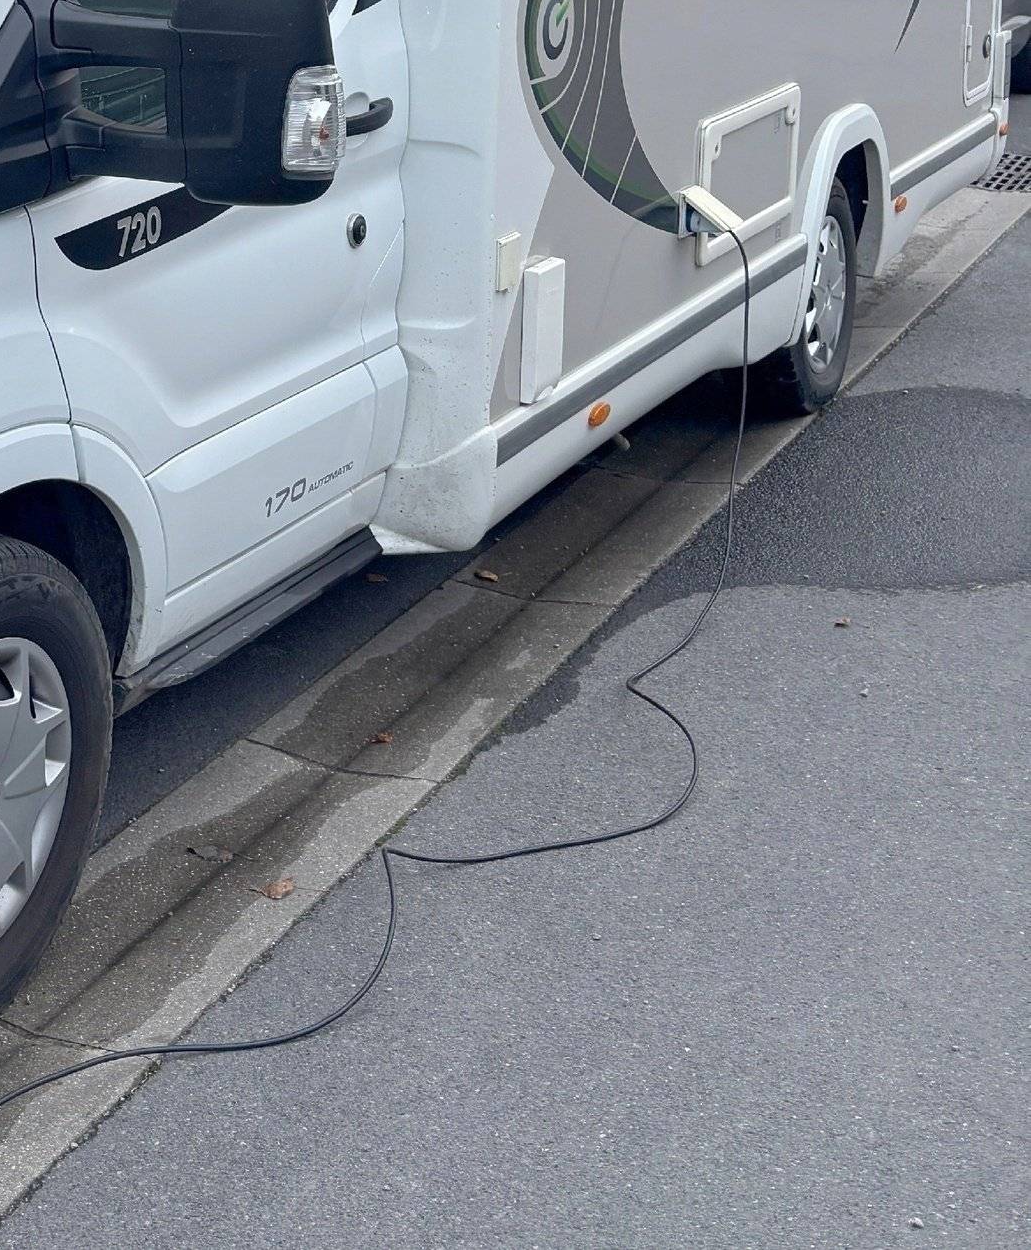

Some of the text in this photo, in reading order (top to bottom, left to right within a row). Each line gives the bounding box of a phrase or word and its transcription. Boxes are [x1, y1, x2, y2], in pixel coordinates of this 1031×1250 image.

[117, 206, 162, 257] 720
[265, 461, 354, 518] 170 AUTOMATIC
